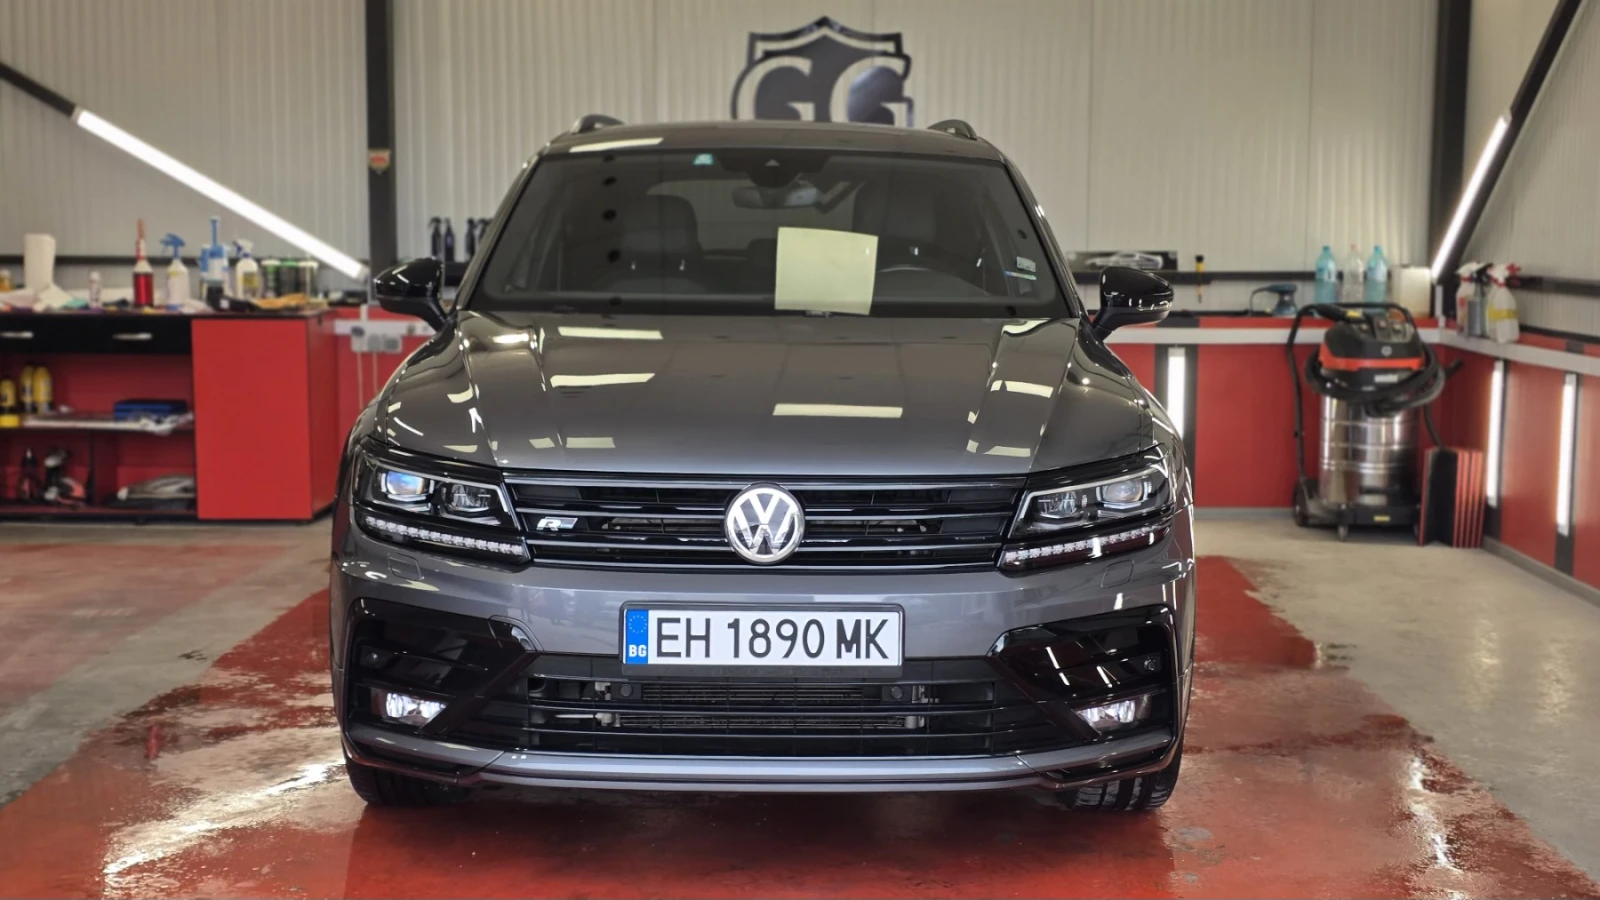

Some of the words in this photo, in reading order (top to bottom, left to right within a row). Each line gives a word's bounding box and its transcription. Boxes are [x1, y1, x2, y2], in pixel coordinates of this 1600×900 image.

[628, 644, 647, 657] BG
[656, 617, 711, 658] EH
[727, 618, 825, 659] 1890
[836, 618, 889, 659] MK
